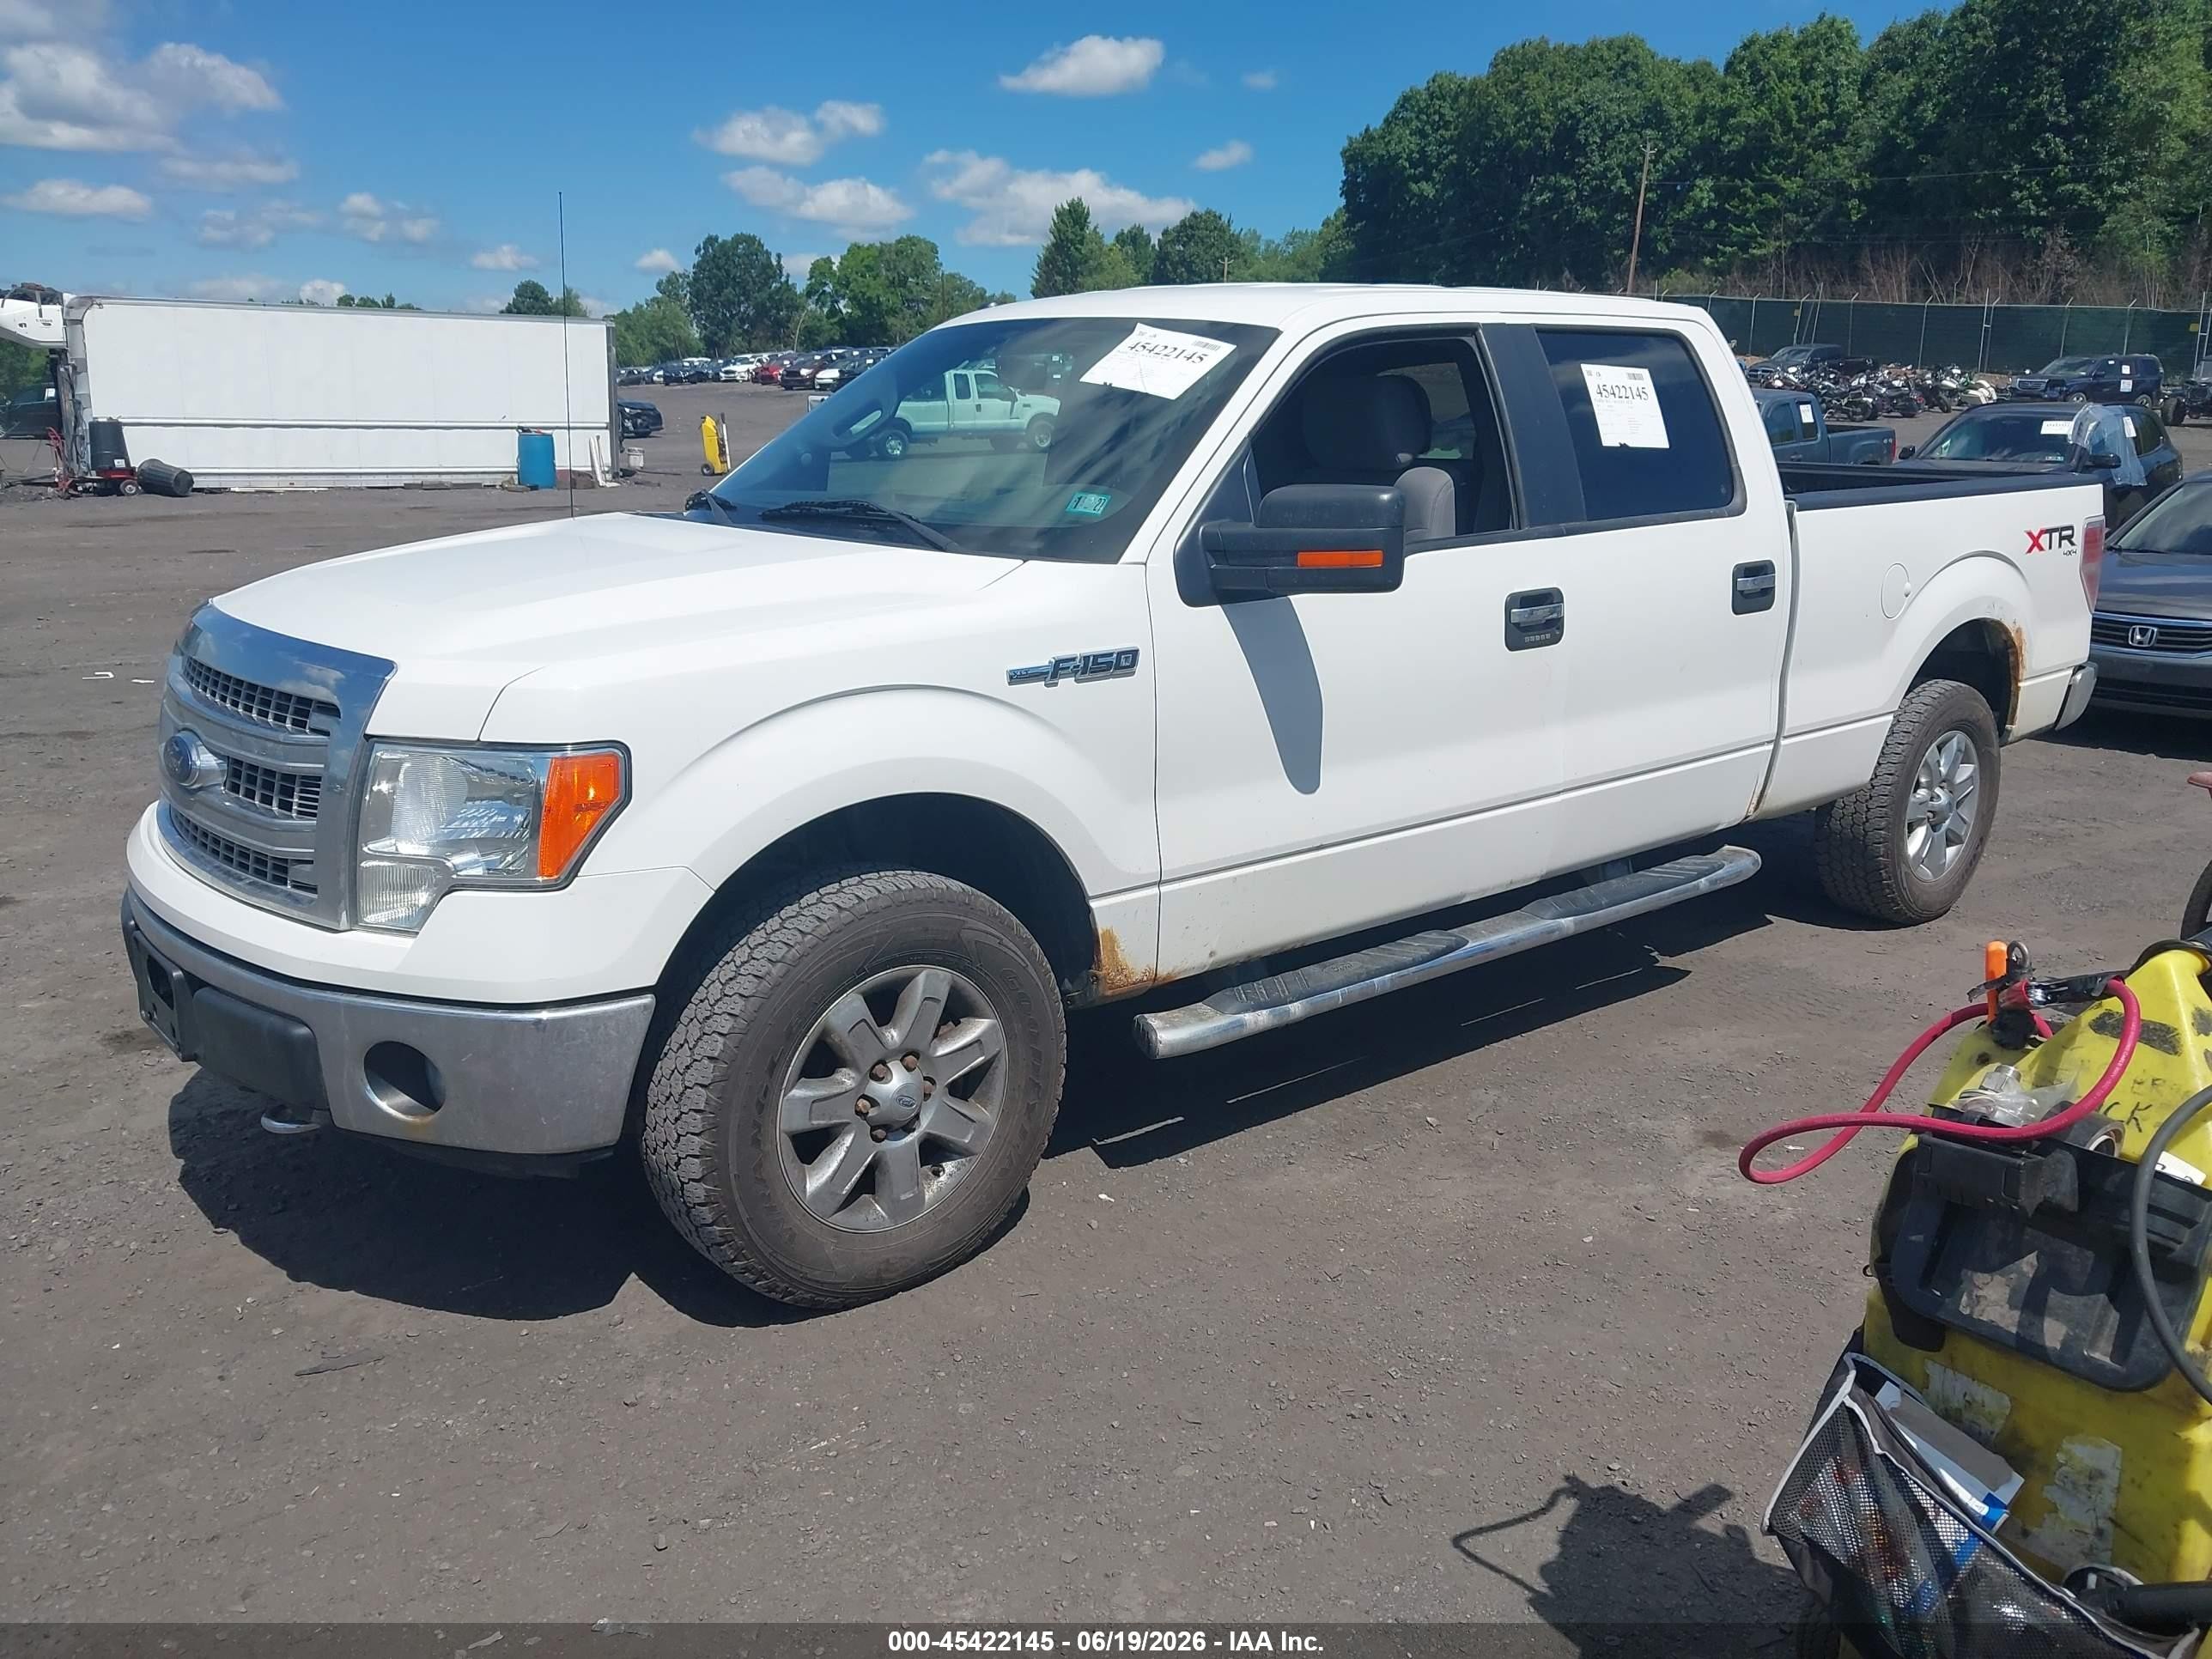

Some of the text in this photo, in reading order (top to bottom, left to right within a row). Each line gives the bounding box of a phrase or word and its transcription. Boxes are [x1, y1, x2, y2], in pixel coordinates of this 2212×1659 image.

[1127, 340, 1209, 364] 45422145
[1595, 384, 1650, 401] 45422145
[2025, 525, 2077, 554] XTR
[1044, 646, 1140, 688] F-150
